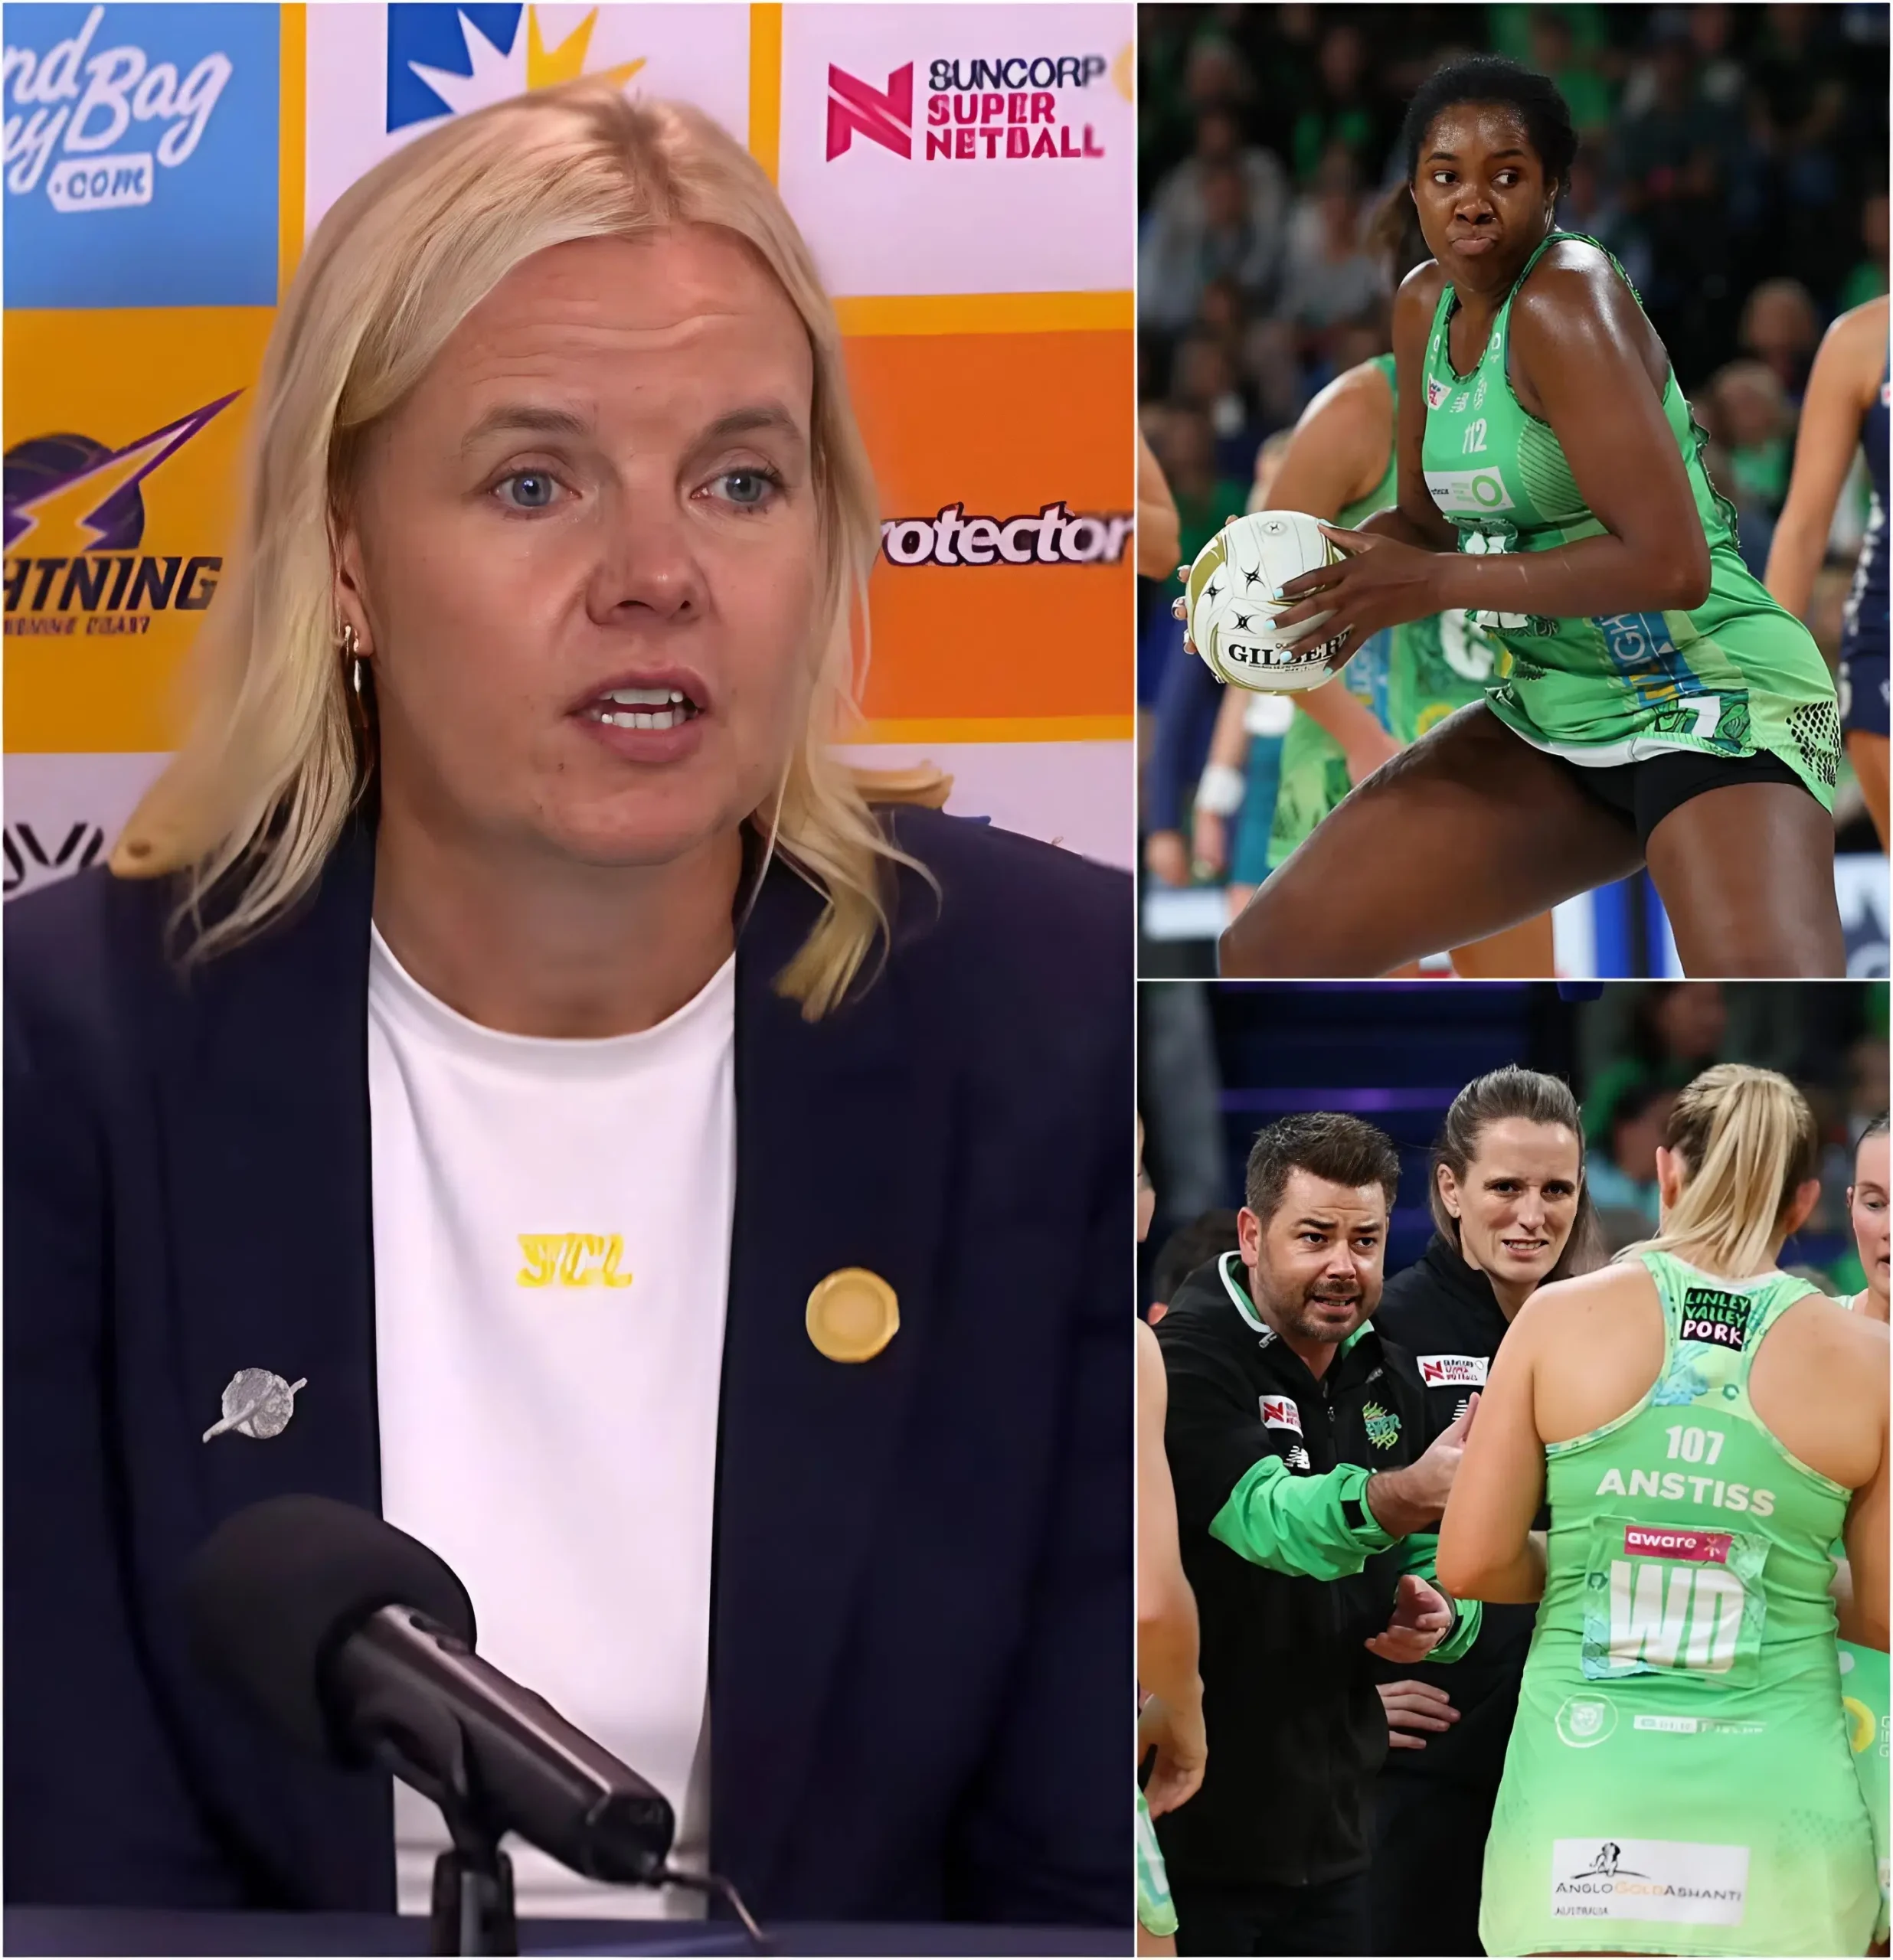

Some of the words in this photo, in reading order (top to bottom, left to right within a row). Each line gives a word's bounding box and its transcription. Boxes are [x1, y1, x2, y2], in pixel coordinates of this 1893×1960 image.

[64, 44, 233, 168] Bag
[927, 91, 1056, 126] SUPER
[926, 122, 1105, 161] NETBALL
[1685, 1292, 1749, 1312] LINLEY
[1685, 1305, 1746, 1329] VALLEY
[1682, 1319, 1743, 1345] PORK
[1666, 1424, 1725, 1465] 107
[1595, 1468, 1777, 1517] ANSTISS
[1627, 1530, 1697, 1550] aware
[1610, 1559, 1744, 1674] WD
